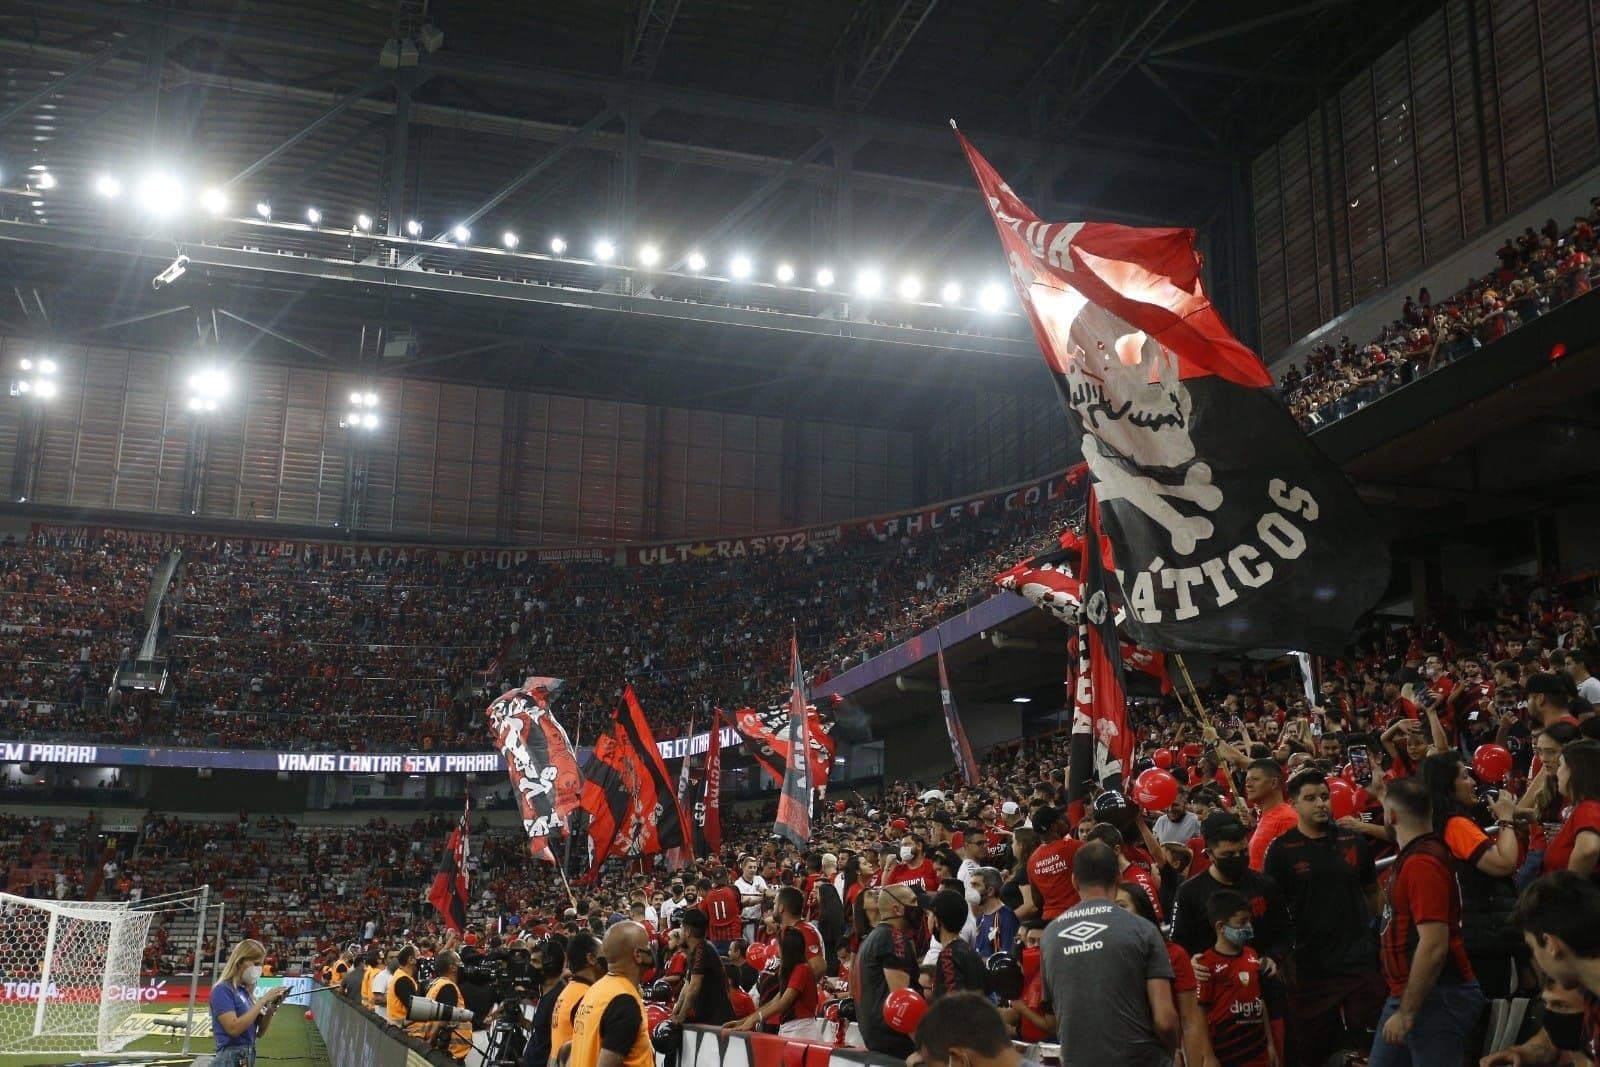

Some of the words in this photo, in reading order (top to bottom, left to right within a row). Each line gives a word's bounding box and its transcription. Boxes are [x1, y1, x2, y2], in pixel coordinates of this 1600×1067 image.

[30, 744, 97, 763] PARAR!
[278, 754, 335, 771] VAMOS
[339, 755, 400, 772] CANTAR
[405, 755, 441, 772] SEM
[445, 754, 498, 772] PARAR!
[713, 901, 727, 920] 11
[1063, 940, 1103, 955] umbro
[107, 983, 158, 1000] Claro
